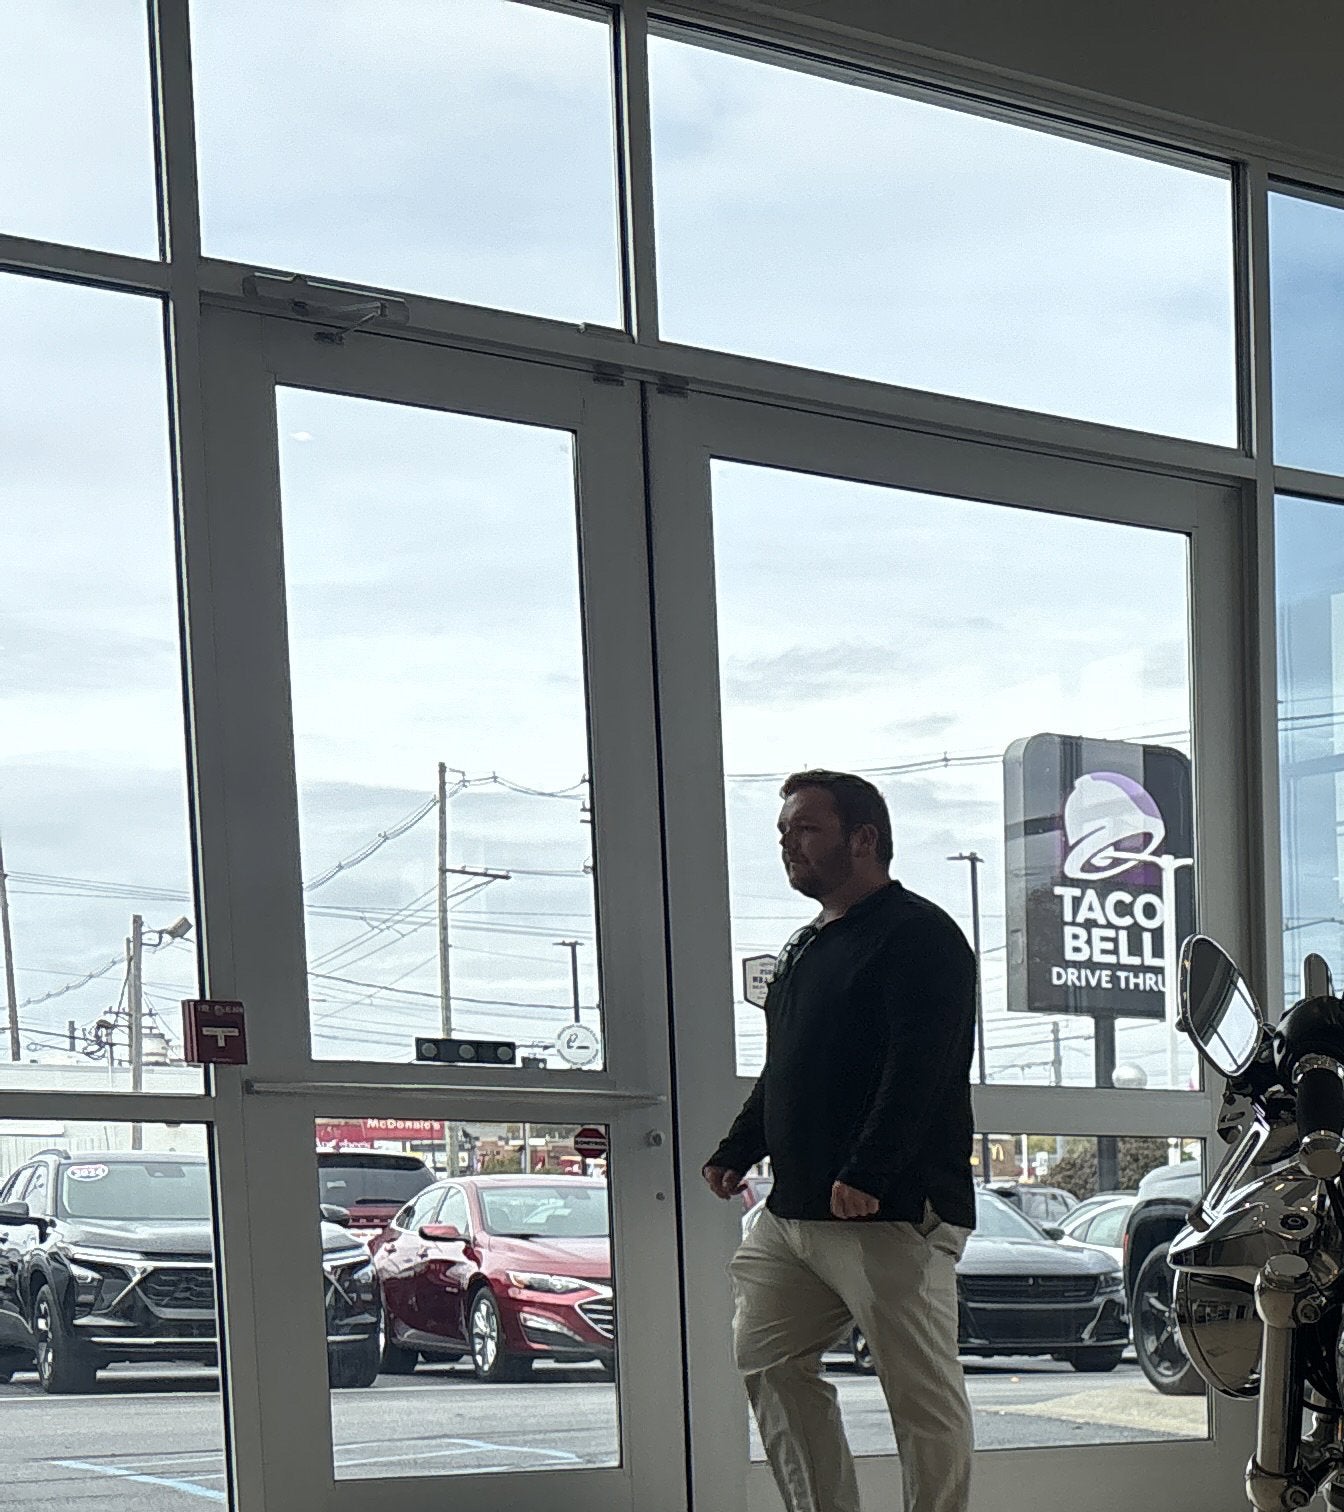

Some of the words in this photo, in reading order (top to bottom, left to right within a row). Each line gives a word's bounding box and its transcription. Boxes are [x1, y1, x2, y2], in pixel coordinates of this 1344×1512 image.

[1054, 886, 1164, 930] TACO
[1063, 925, 1165, 968] BELL
[1052, 966, 1112, 989] DRIVE
[366, 1118, 441, 1131] McDonald's
